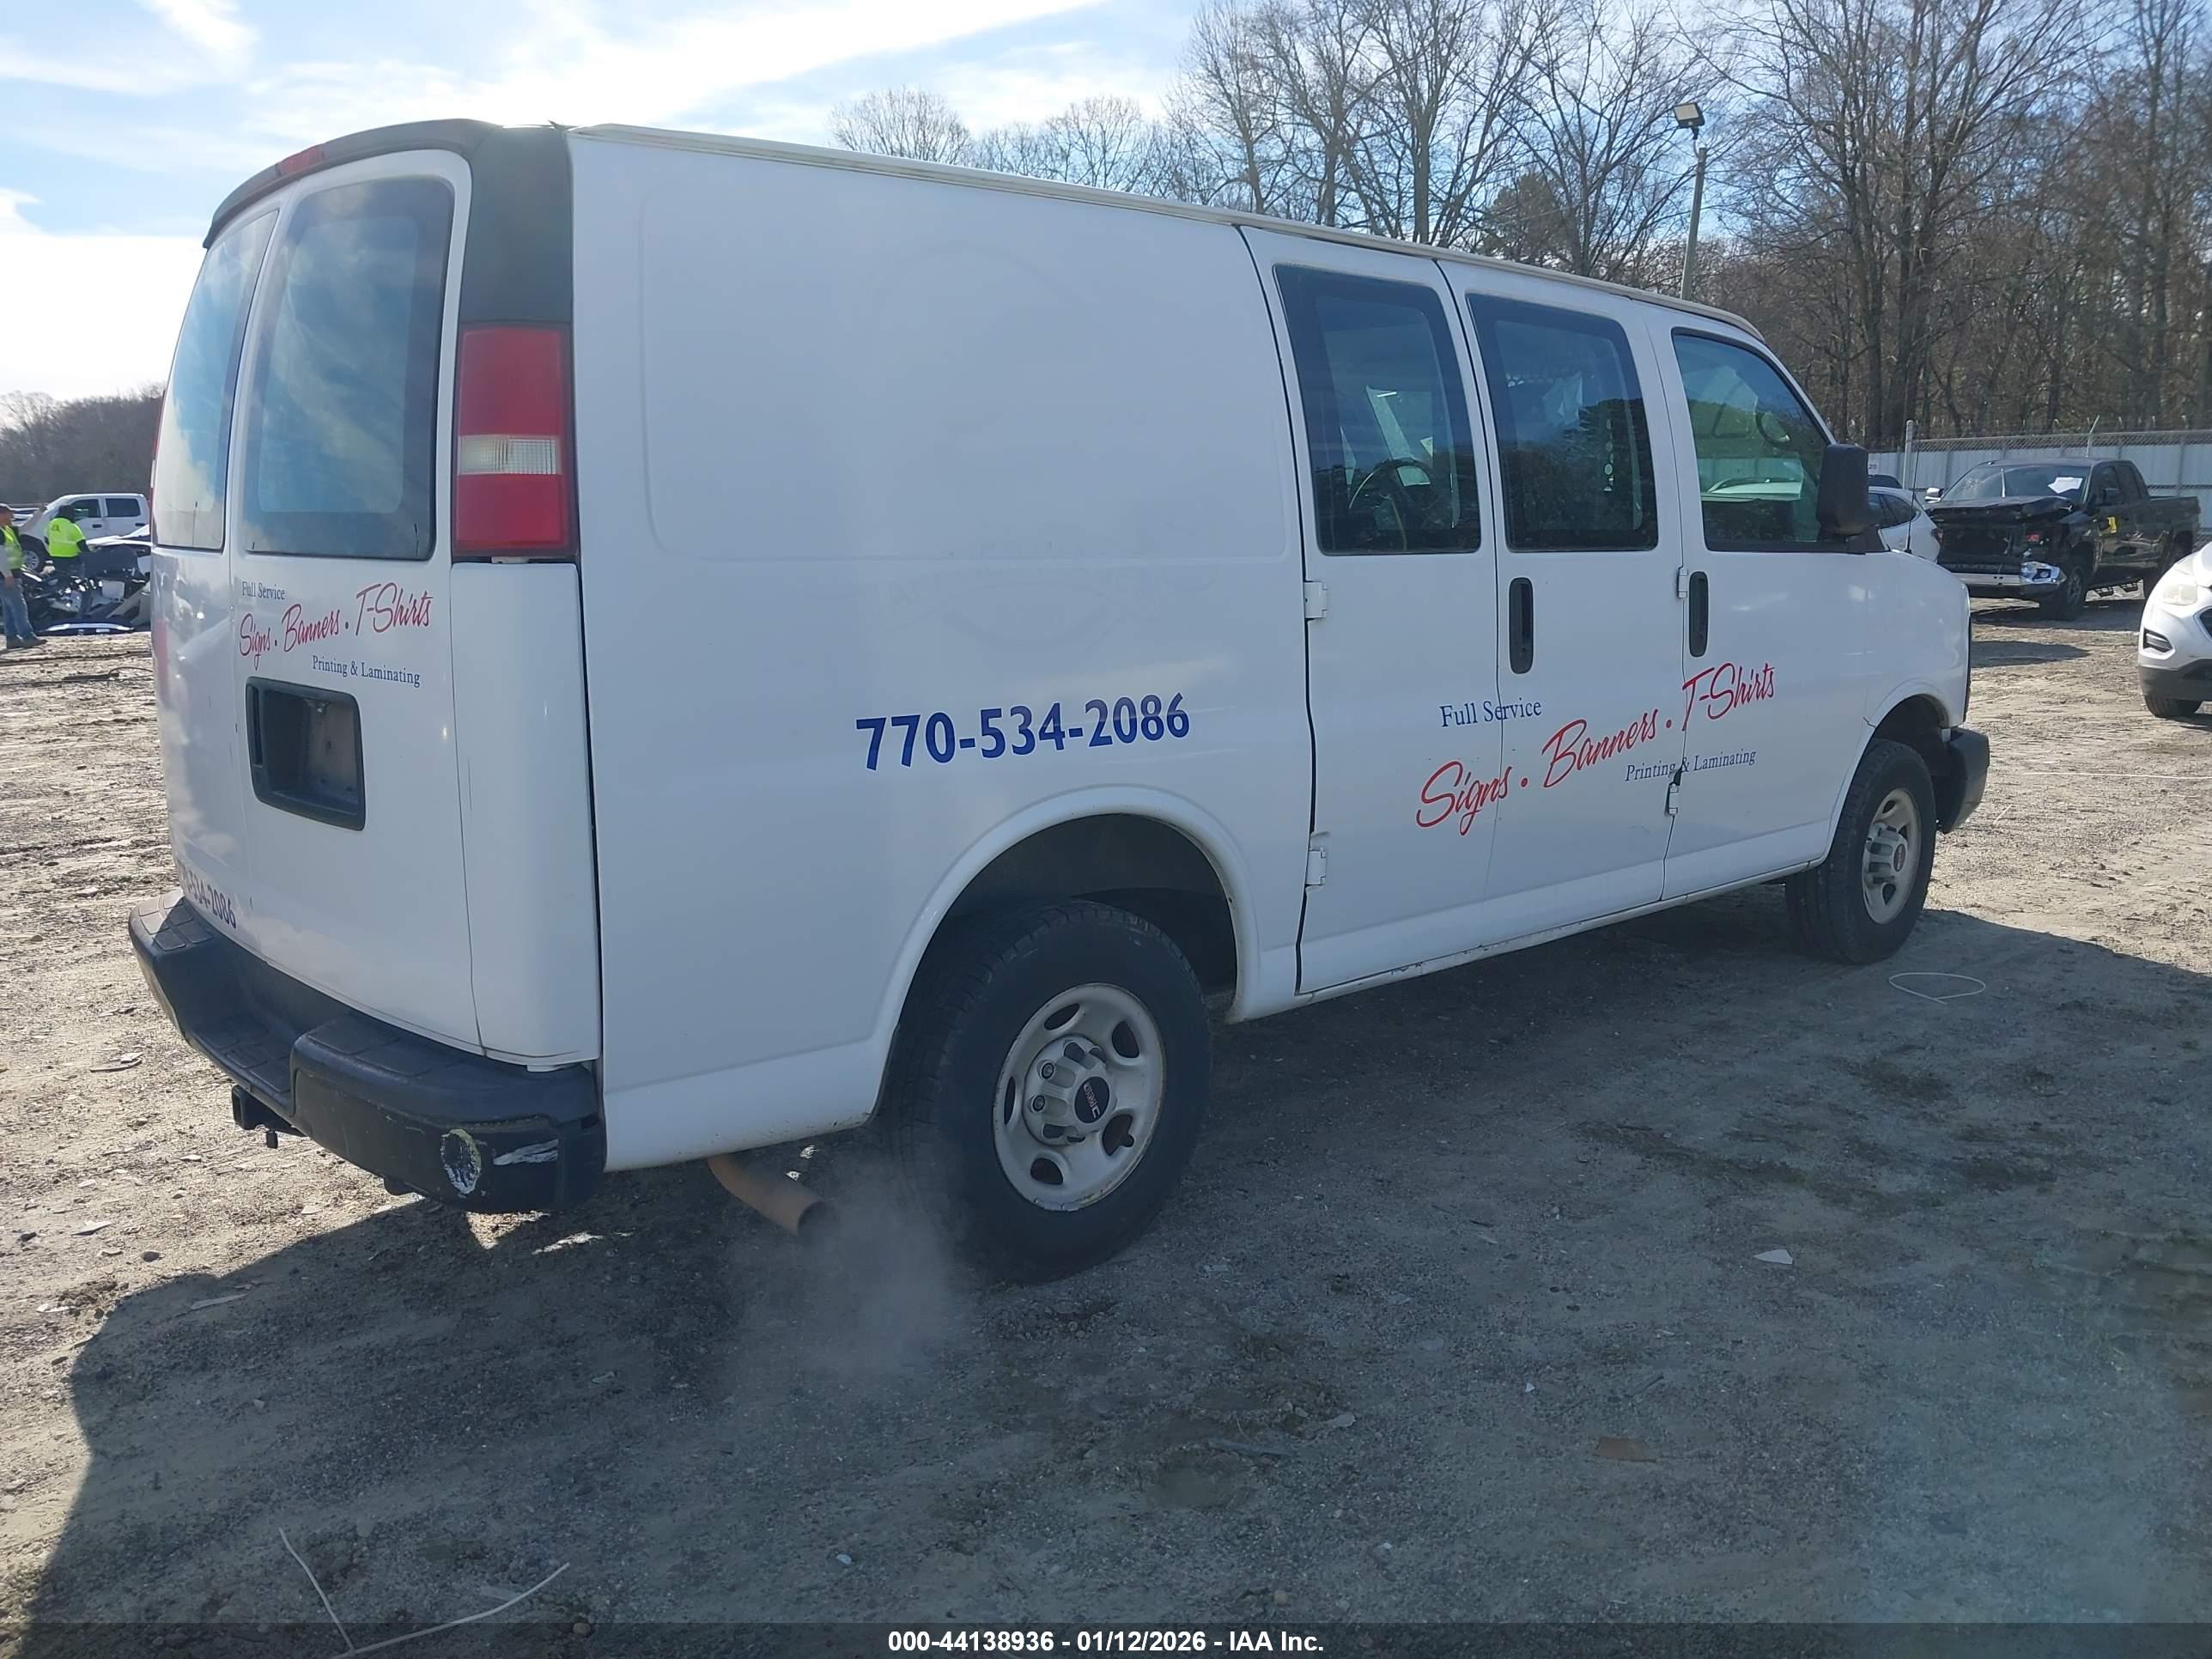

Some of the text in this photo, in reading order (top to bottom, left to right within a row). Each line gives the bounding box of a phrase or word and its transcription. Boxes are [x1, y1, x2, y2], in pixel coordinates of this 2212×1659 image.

[241, 581, 286, 600] Full Service
[239, 582, 434, 671] Signs Banners T-Shirts
[312, 655, 421, 688] Printing & Laminating
[1439, 697, 1542, 727] Full Service
[855, 692, 1190, 771] 770-534-2086
[1416, 662, 1776, 836] Signs Banners T-Shirts
[1625, 749, 1757, 782] Printing & Laminating
[1082, 1081, 1101, 1119] GMC
